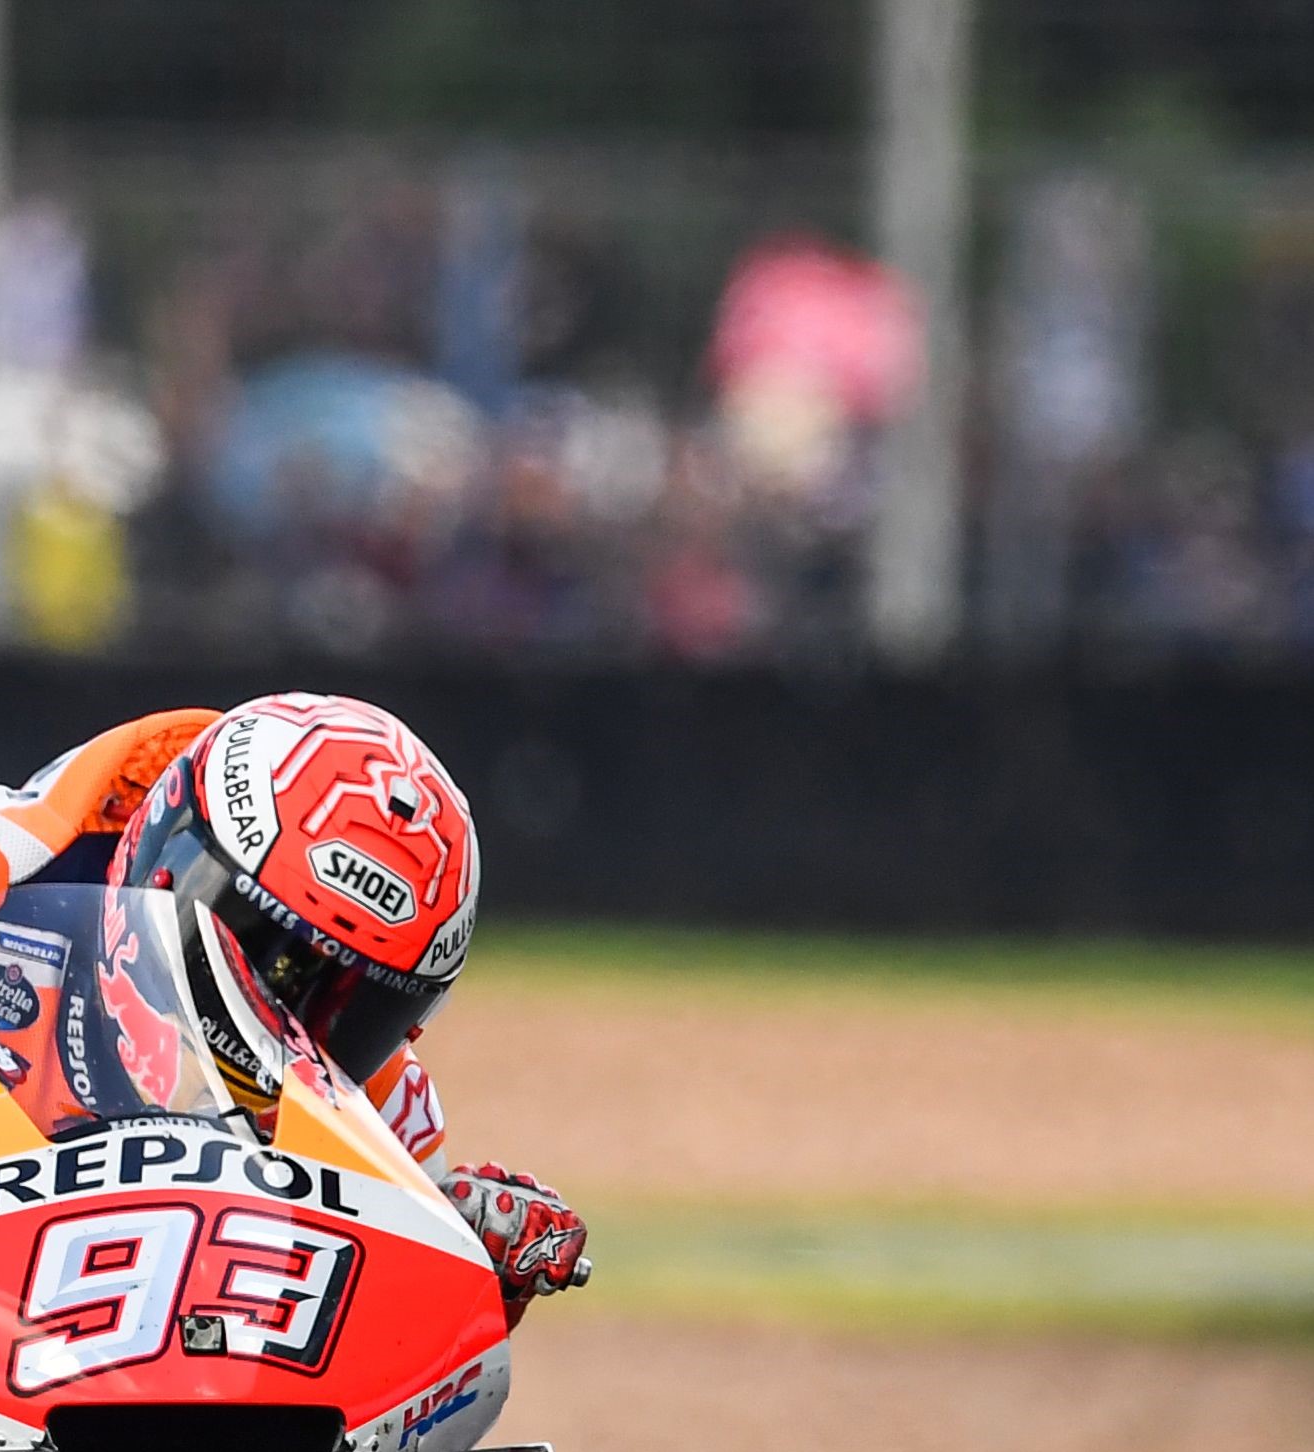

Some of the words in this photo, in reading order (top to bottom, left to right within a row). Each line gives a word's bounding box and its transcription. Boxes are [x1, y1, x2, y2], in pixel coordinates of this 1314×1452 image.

[225, 718, 265, 855] PULL&BEAR
[321, 845, 409, 918] SHOEI
[2, 937, 62, 962] MICHELIN
[234, 872, 300, 930] GIVES
[310, 929, 358, 966] YOU
[365, 962, 427, 997] WINGS
[66, 995, 98, 1106] REPSOL
[108, 1116, 215, 1131] HONDA
[7, 1200, 365, 1398] 93
[397, 1361, 483, 1451] HRC
